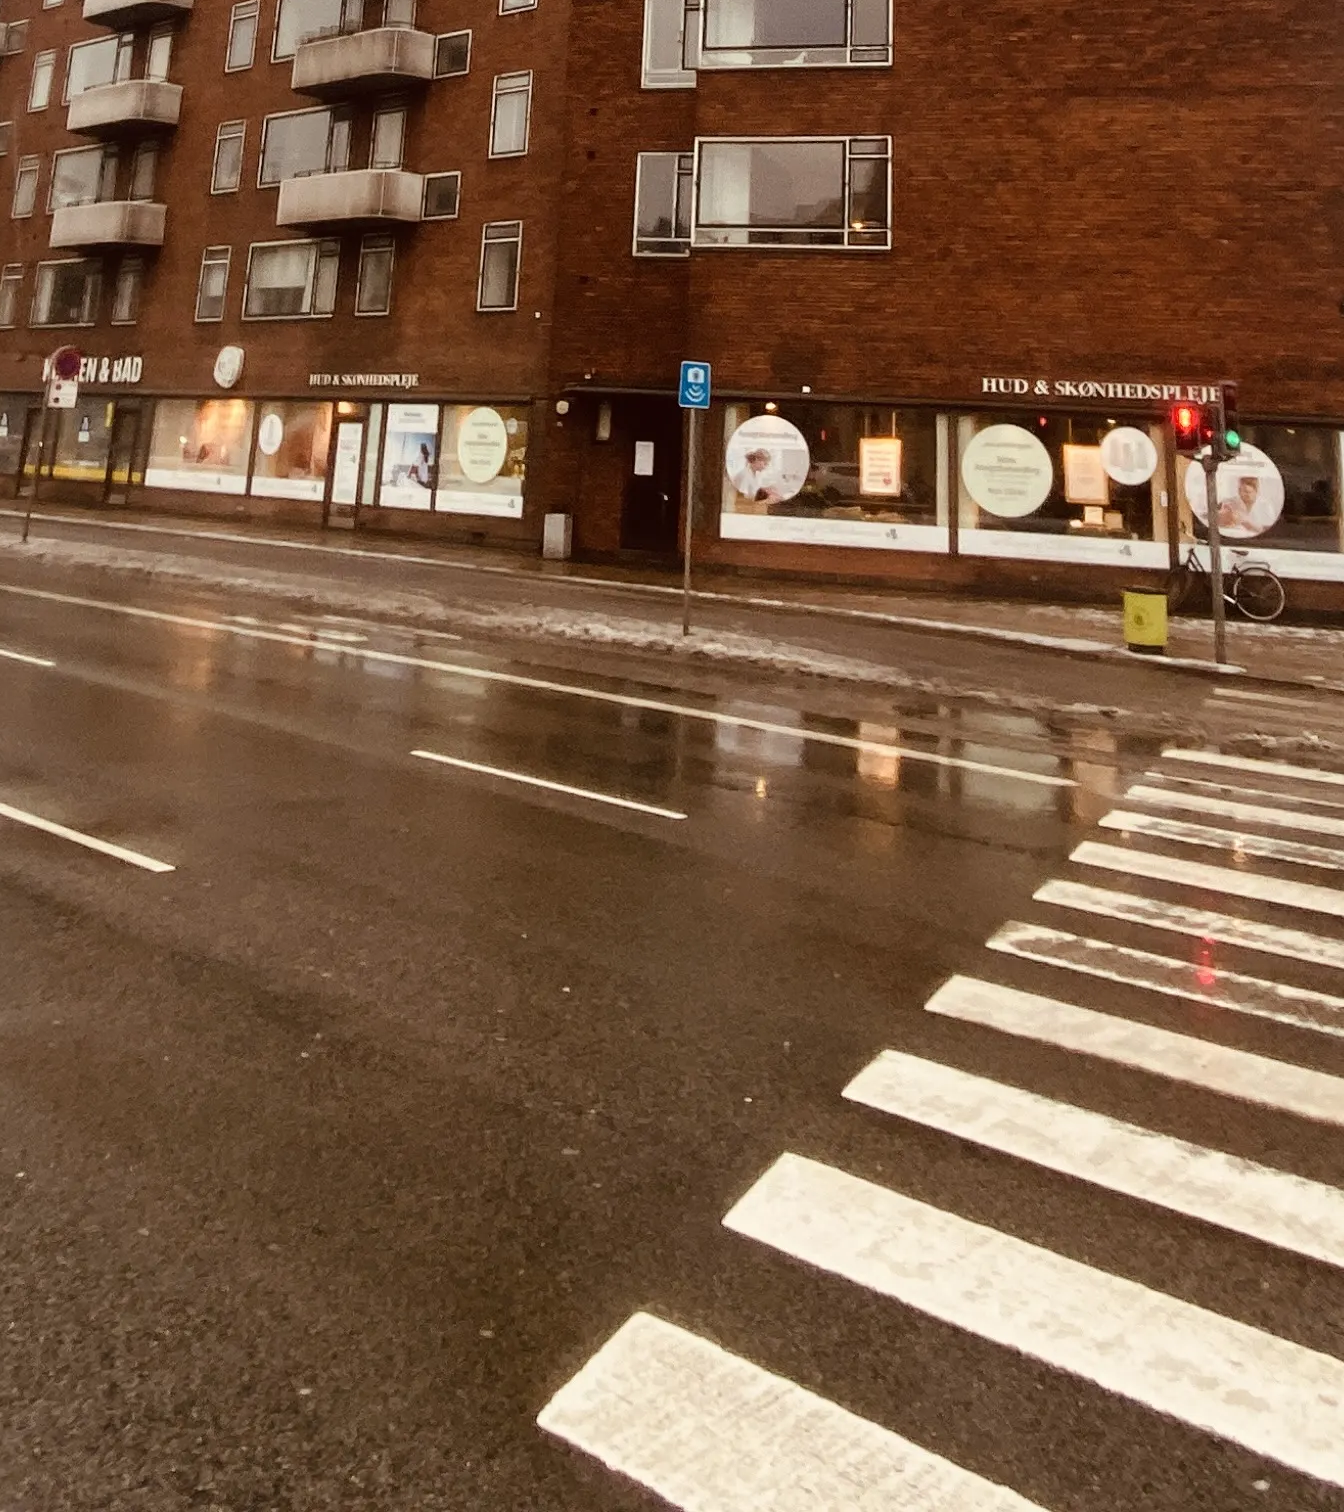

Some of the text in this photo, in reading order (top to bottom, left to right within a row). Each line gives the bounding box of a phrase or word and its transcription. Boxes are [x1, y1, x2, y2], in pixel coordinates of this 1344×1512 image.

[99, 356, 110, 383] &
[112, 356, 143, 383] BAD
[982, 377, 1221, 405] HUD & SKØNHEDSPLEJE
